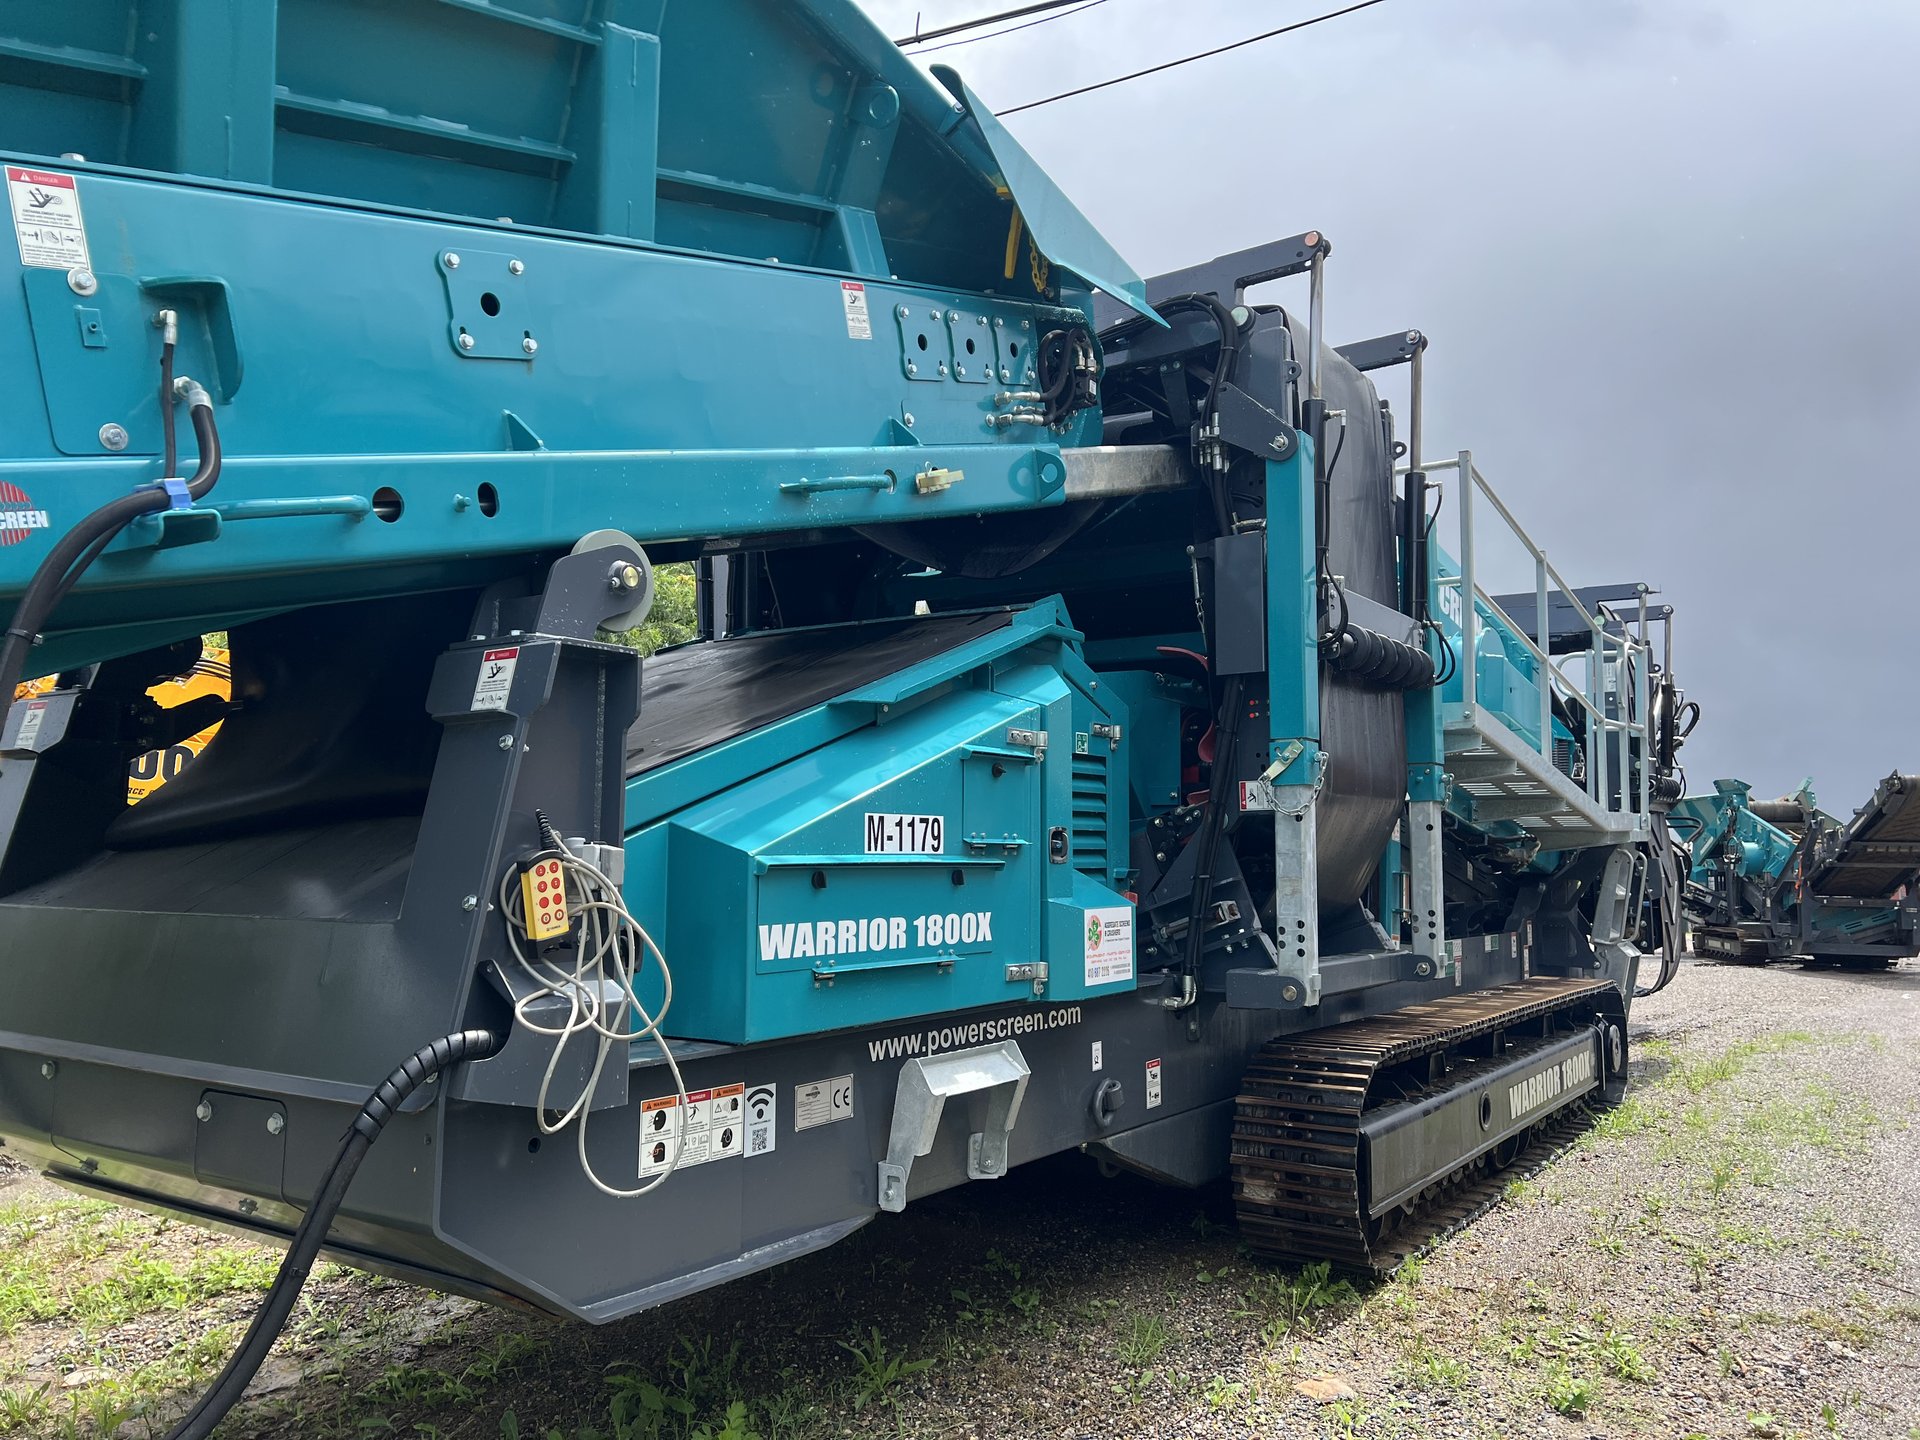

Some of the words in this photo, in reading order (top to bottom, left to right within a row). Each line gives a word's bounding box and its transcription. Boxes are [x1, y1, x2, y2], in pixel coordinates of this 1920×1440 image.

[867, 815, 941, 852] M-1179
[758, 916, 907, 961] WARRIOR
[913, 911, 993, 948] 1800X
[868, 1006, 1081, 1062] www.powerscreen.com
[1509, 1064, 1561, 1120] WARRIOR
[1561, 1050, 1591, 1090] 1800X
